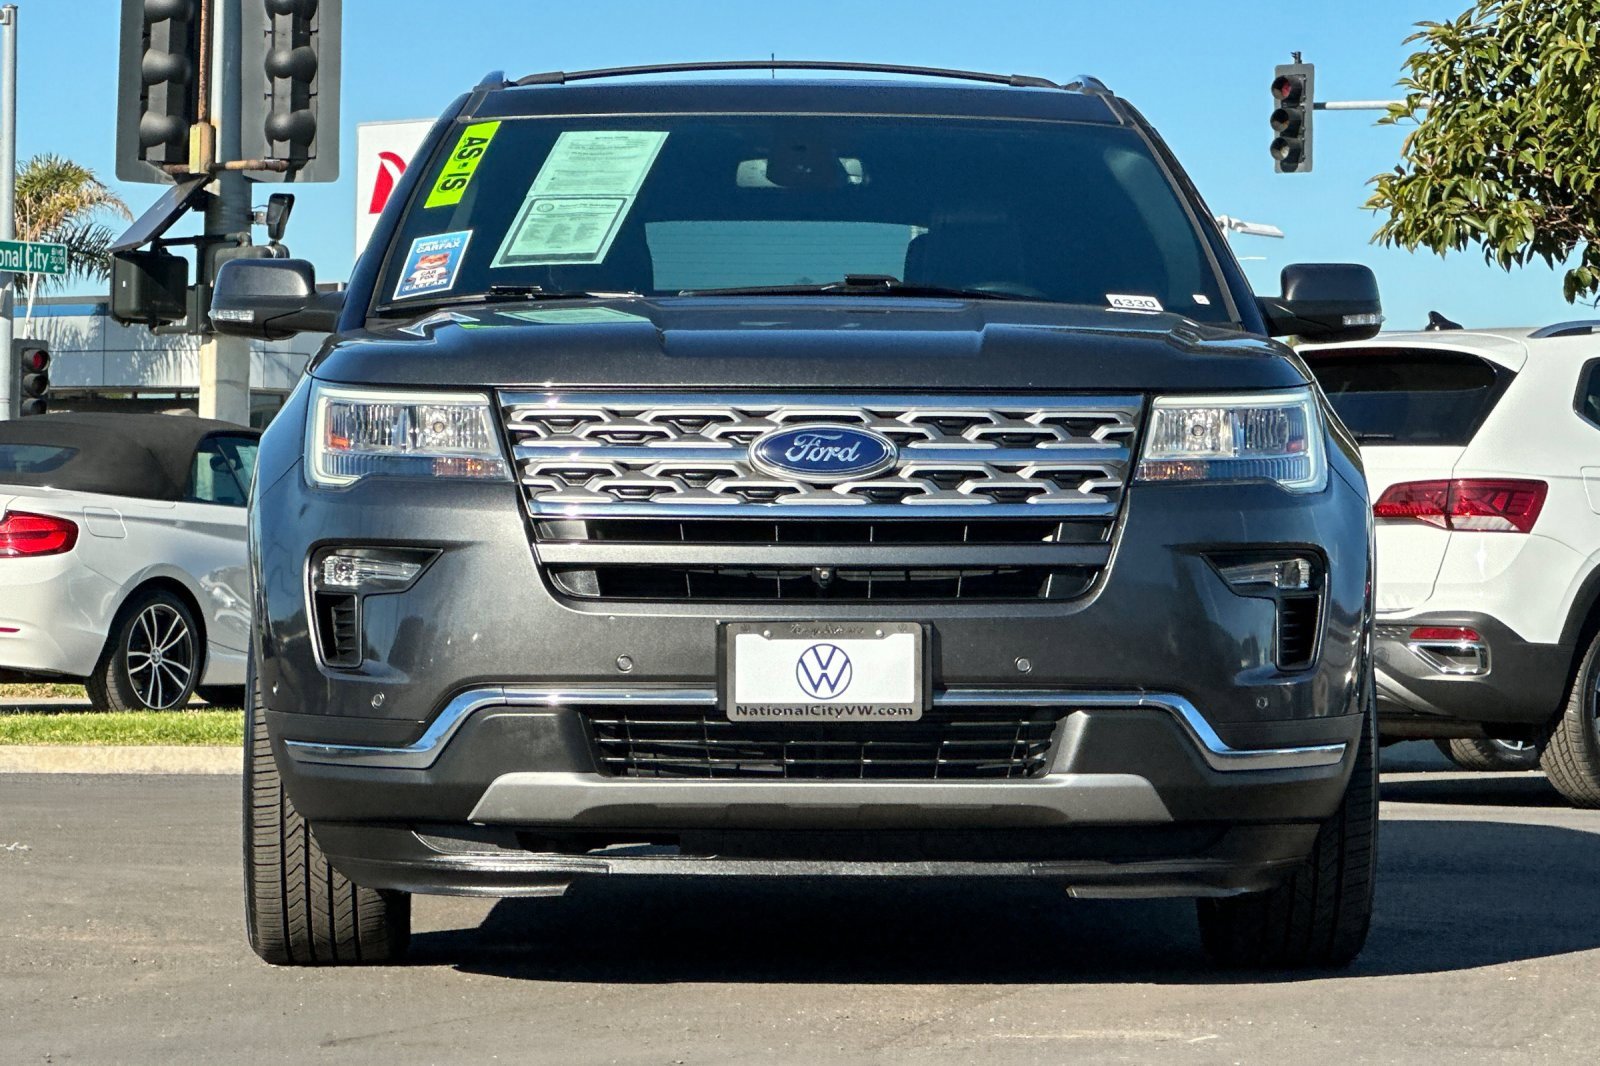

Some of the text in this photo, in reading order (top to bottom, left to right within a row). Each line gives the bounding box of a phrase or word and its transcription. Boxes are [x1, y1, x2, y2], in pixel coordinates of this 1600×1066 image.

[416, 241, 461, 254] CARFAX
[25, 245, 49, 272] City
[1113, 298, 1156, 308] 4330
[785, 433, 862, 462] Ford
[736, 705, 913, 718] NationalCityVW.com
